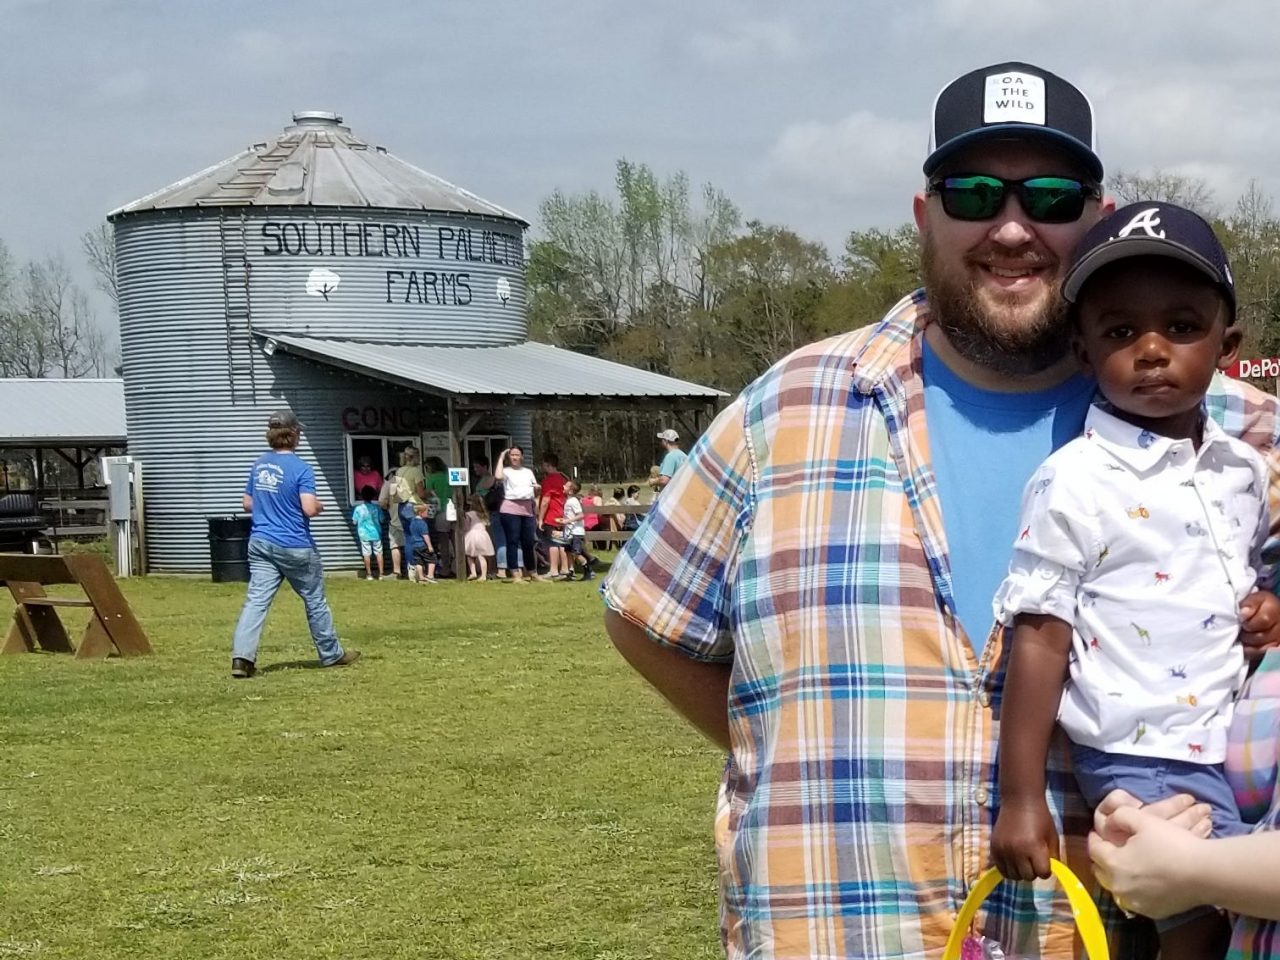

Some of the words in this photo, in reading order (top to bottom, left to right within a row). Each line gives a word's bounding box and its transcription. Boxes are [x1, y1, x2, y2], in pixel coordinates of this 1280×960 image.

[1001, 88, 1029, 97] THE
[995, 100, 1034, 110] WILD
[261, 222, 421, 258] SOUTHERN
[386, 271, 473, 306] FARMS
